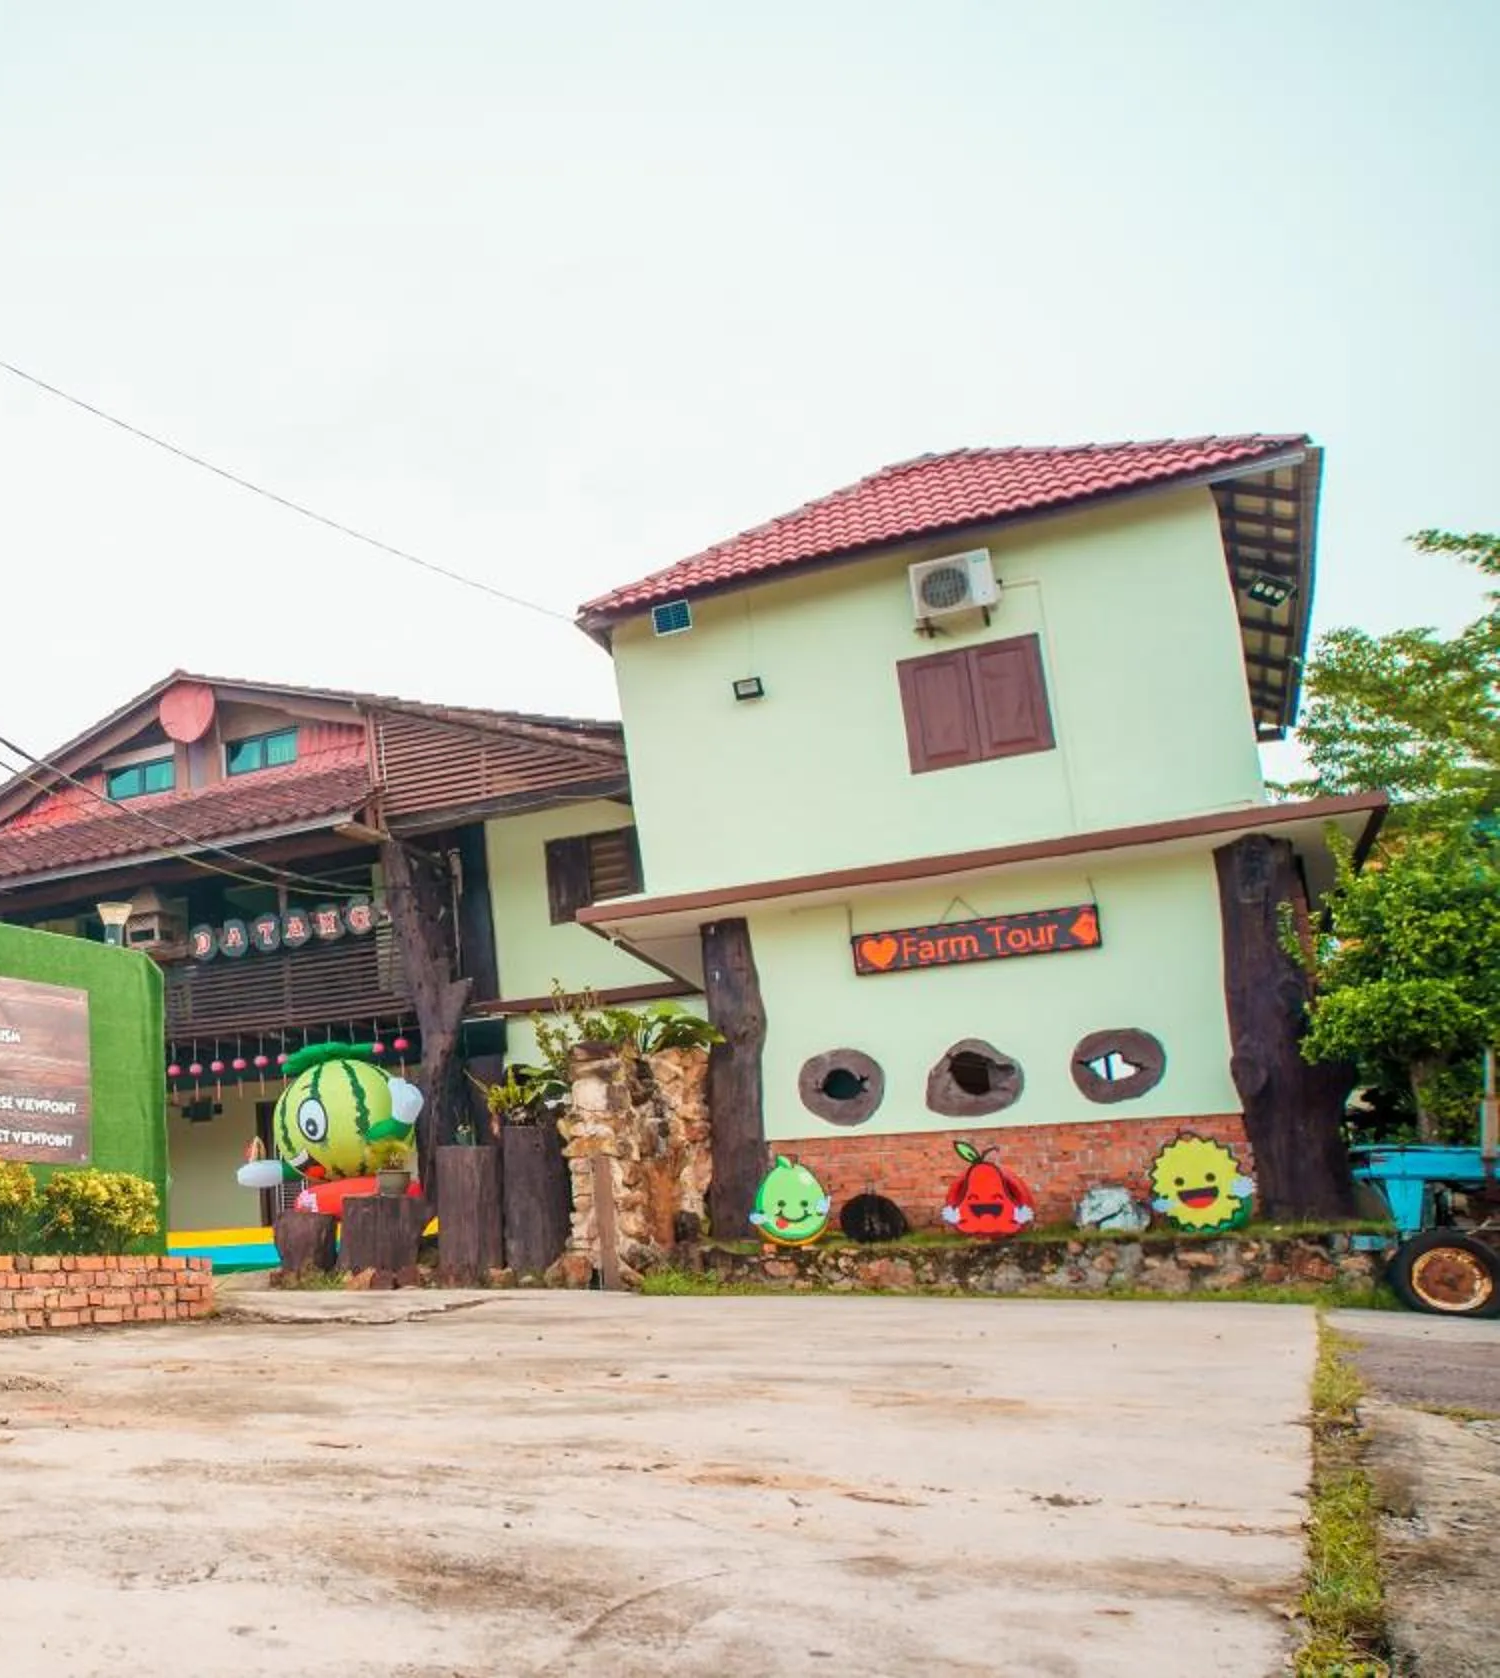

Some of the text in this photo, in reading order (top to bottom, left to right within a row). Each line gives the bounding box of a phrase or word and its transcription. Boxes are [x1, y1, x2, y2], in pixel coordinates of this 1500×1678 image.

[193, 904, 371, 955] DATANG
[902, 924, 1059, 961] Farm Tour
[15, 1097, 77, 1115] VIEWPOINT
[12, 1131, 74, 1148] VIEWPOINT
